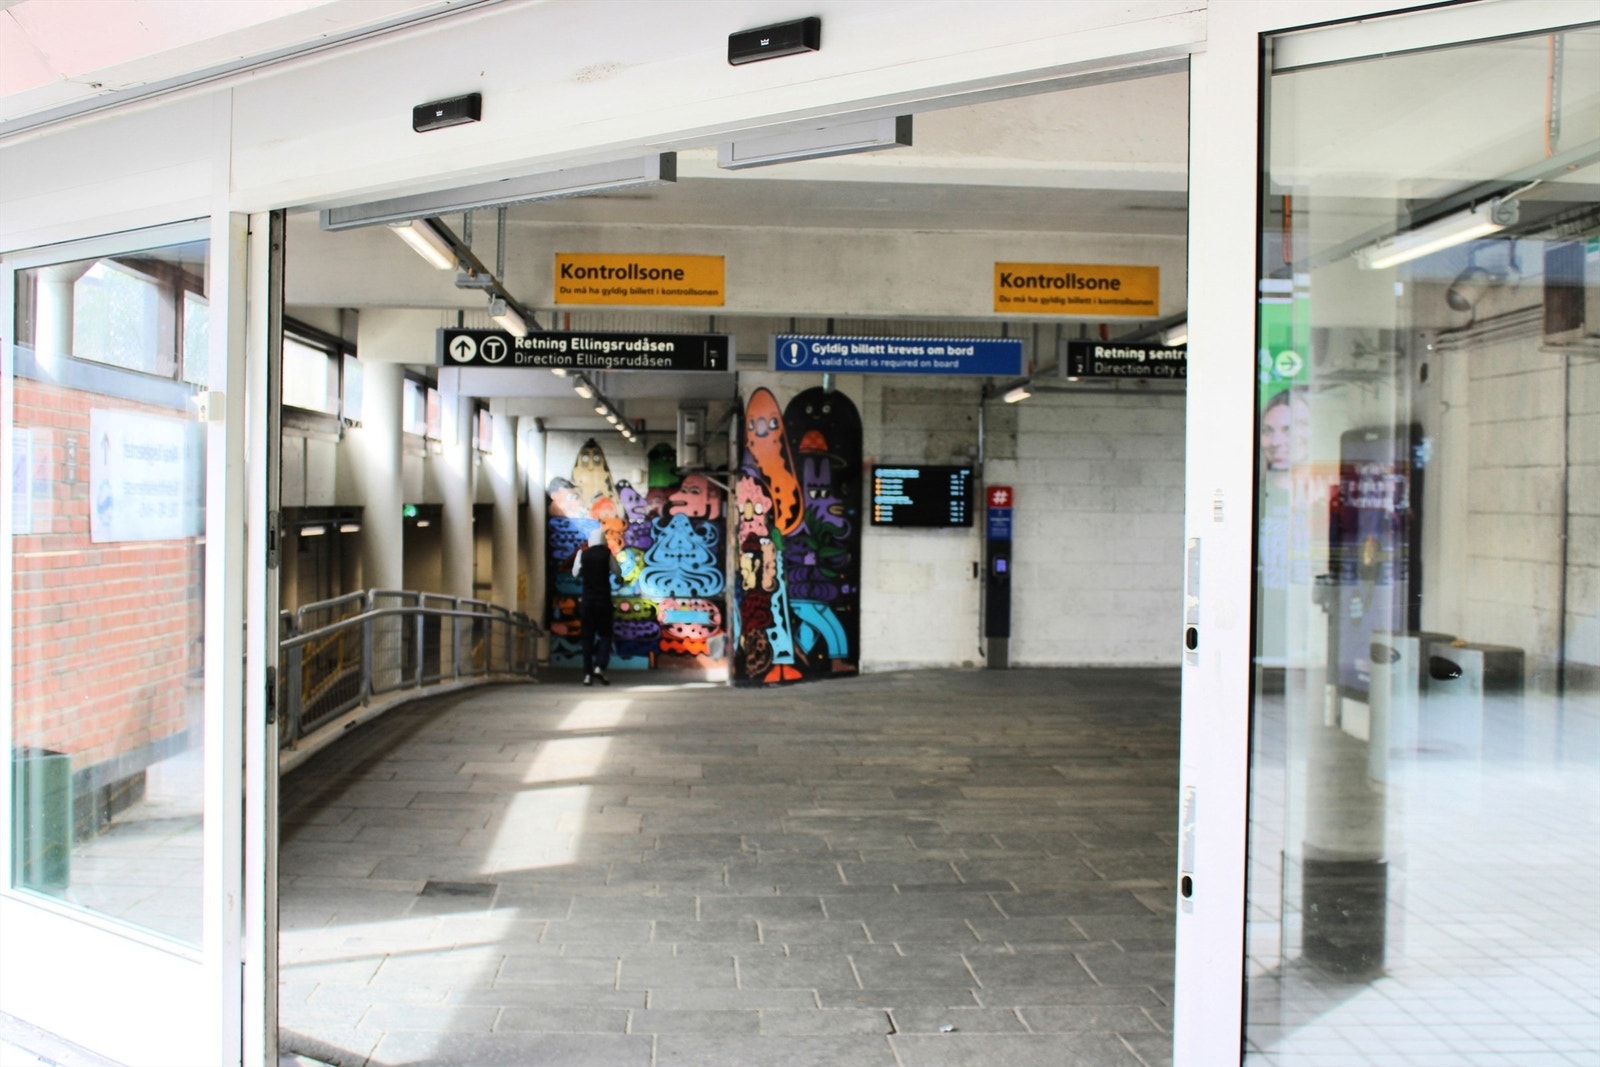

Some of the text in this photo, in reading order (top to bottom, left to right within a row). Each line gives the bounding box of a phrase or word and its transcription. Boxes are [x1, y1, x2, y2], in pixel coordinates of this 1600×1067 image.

[560, 263, 685, 281] Kontrollsone
[1000, 272, 1121, 291] Kontrollsone
[560, 286, 572, 294] Du
[574, 286, 587, 294] må
[589, 286, 599, 294] ha
[601, 286, 628, 296] gyldig
[630, 287, 654, 295] billett
[661, 287, 719, 296] kontrollsonen
[514, 337, 675, 353] Retning Ellingsrudåsen
[811, 343, 975, 356] Gyldig billett kreves om bord
[514, 352, 673, 369] Direction Ellingsrudåsen
[1094, 345, 1146, 363] Retning
[710, 358, 716, 368] 1
[811, 357, 960, 369] A valid ticket is required on board
[1094, 362, 1151, 374] Direction
[1153, 364, 1176, 377] city
